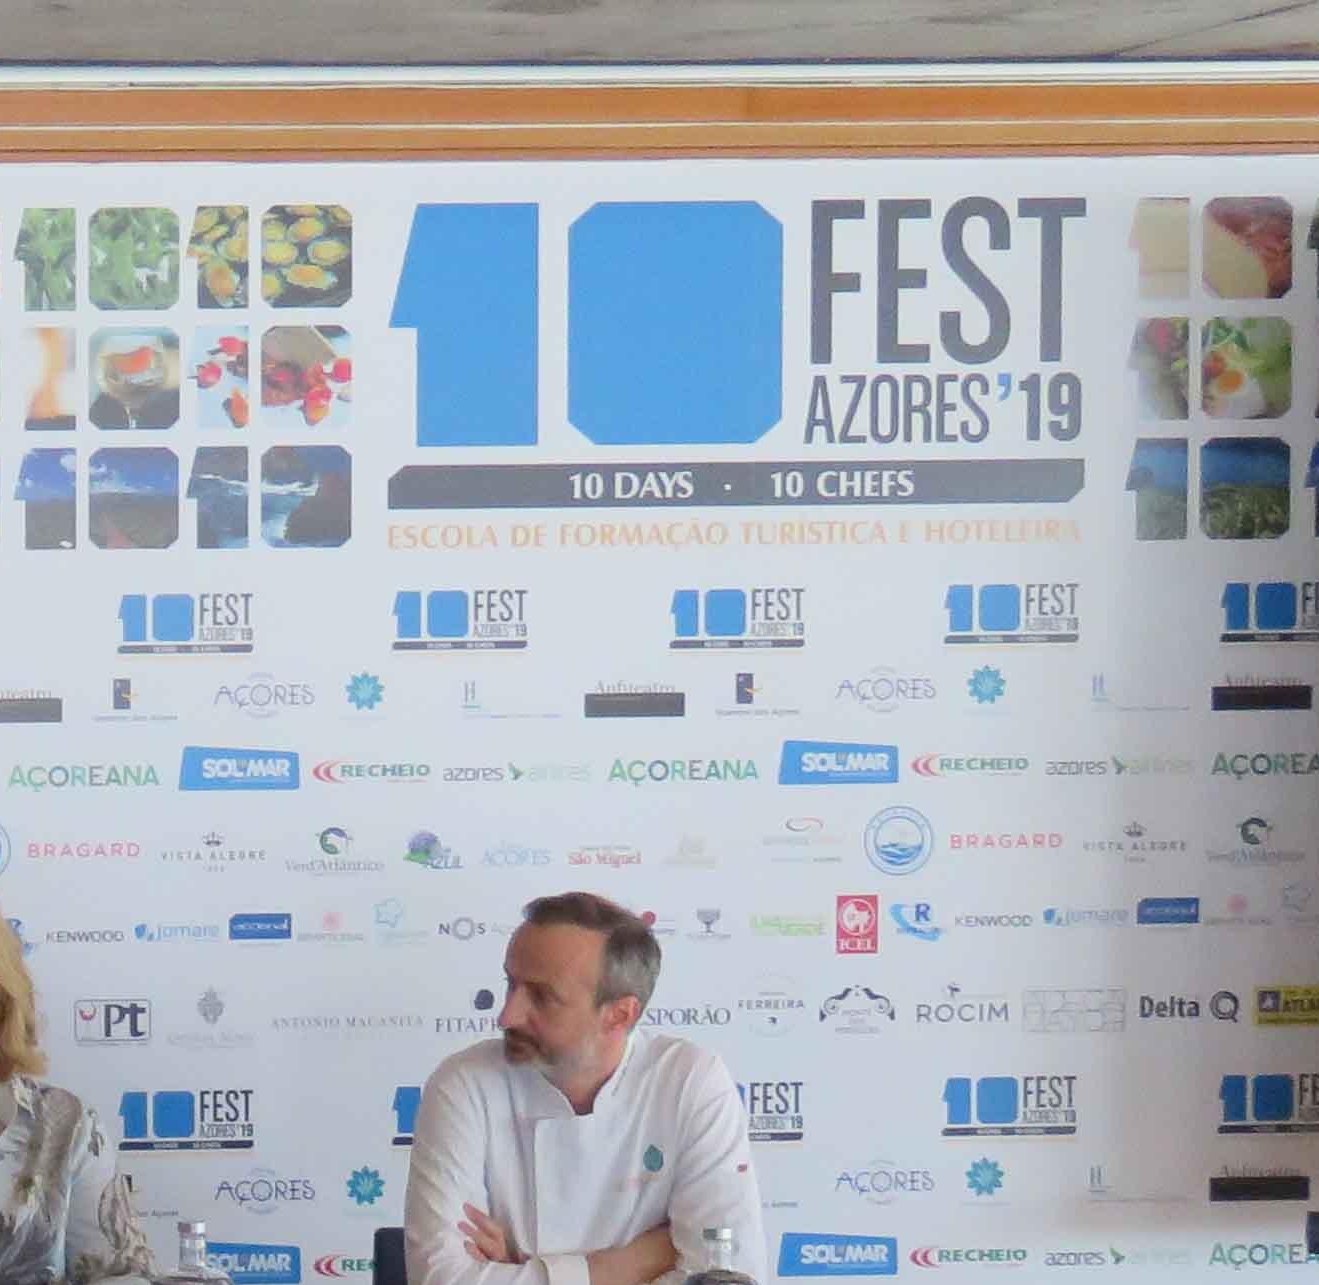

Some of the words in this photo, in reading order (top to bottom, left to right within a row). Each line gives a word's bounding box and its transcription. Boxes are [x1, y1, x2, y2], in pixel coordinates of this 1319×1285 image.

[811, 196, 1086, 364] FEST
[569, 472, 603, 499] 10
[614, 471, 694, 499] DAYS
[770, 471, 803, 498] 10
[816, 470, 914, 498] CHEFS
[387, 523, 498, 549] ESCOLA
[510, 523, 547, 548] DE
[560, 518, 727, 553] FORMAÇÃO
[898, 521, 908, 543] E
[925, 519, 1082, 545] HOTELEIRA
[199, 593, 253, 625] FEST
[473, 590, 528, 622] FEST
[751, 588, 805, 621] FEST
[1025, 583, 1079, 615] FEST
[214, 684, 316, 709] AÇORES
[835, 679, 936, 702] AÇORES
[340, 762, 430, 778] RECHEIO
[443, 765, 504, 782] azores
[609, 758, 759, 786] AÇOREANA
[939, 756, 1030, 771] RECHEIO
[8, 764, 160, 792] AÇOREANA
[27, 842, 140, 859] BRAGARD
[950, 833, 1062, 849] BRAGARD
[954, 915, 1033, 928] KENWOOD
[46, 930, 125, 943] KENWOOD
[646, 1003, 731, 1026] SPORÃO
[916, 1003, 1010, 1023] ROCIM
[1139, 995, 1200, 1018] Delta
[104, 1003, 146, 1037] Pt
[748, 1081, 803, 1114] FEST
[1023, 1075, 1077, 1108] FEST
[199, 1090, 253, 1122] FEST
[392, 1086, 421, 1133] 1
[214, 1179, 316, 1206] AÇORES
[835, 1170, 935, 1196] AÇORES
[938, 1248, 1028, 1263] RECHEIO
[1045, 1249, 1105, 1267] azores
